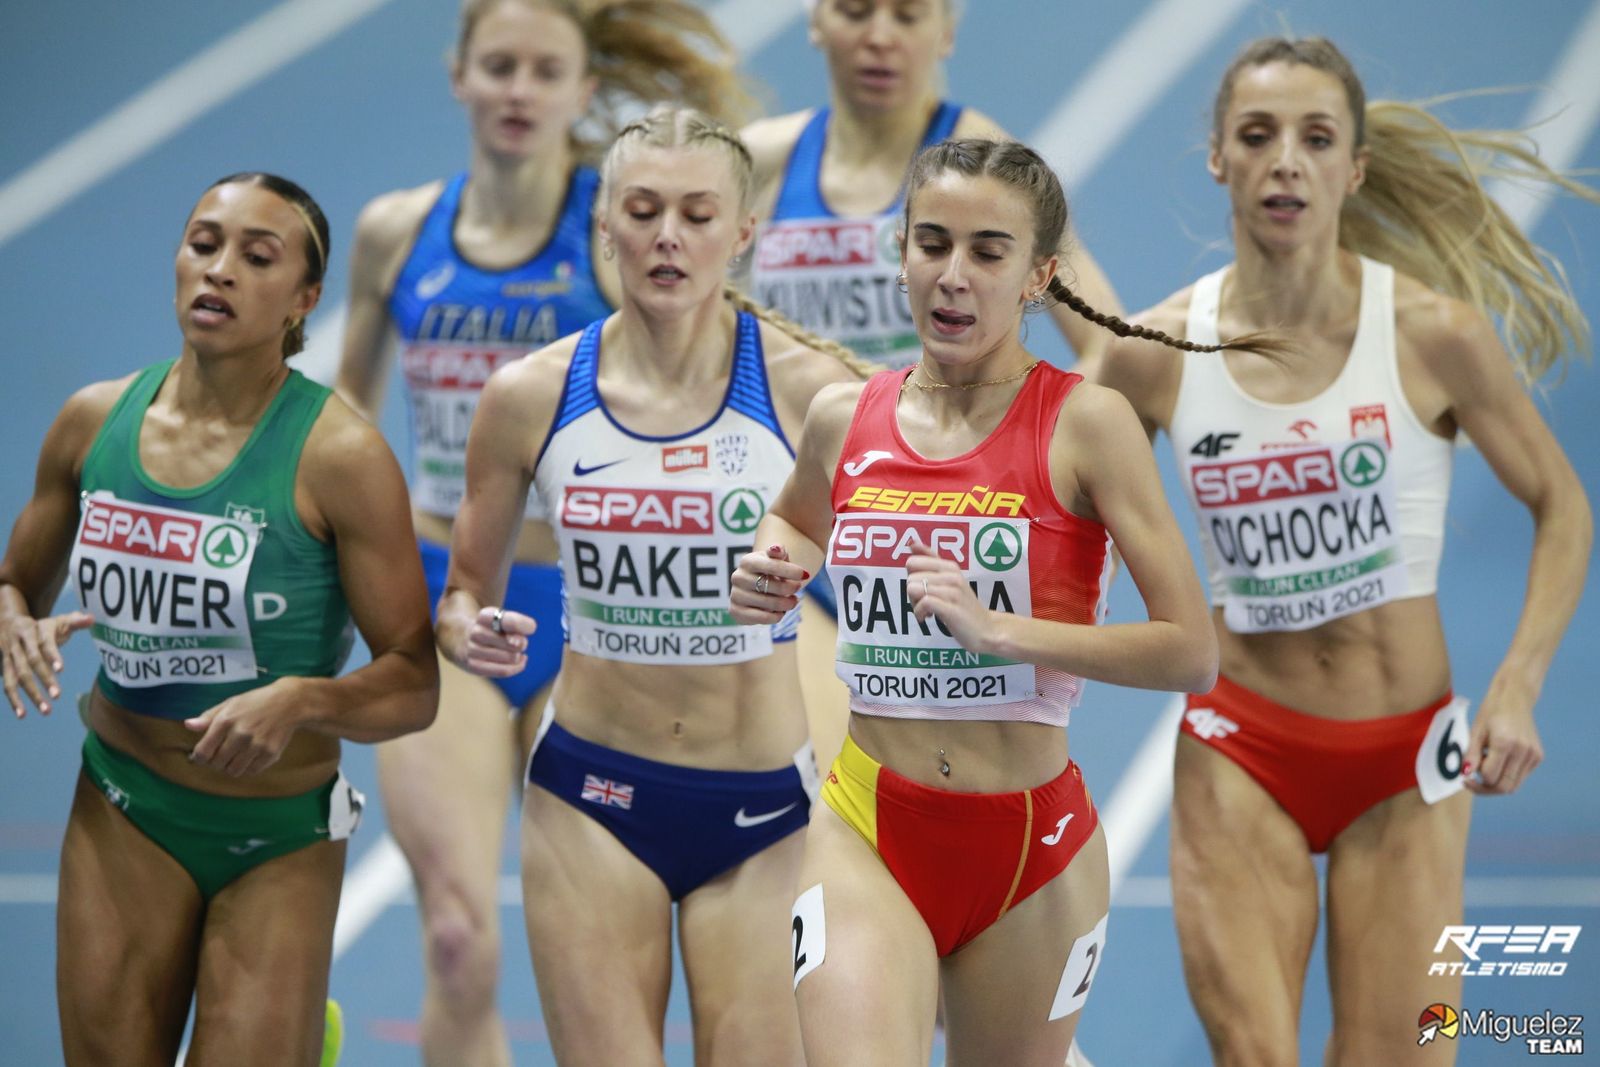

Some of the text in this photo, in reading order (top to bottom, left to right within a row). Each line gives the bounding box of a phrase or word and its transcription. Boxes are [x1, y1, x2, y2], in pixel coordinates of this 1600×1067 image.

[760, 226, 871, 266] SPAR
[418, 303, 558, 342] ITALIA
[1190, 432, 1241, 459] 4F
[1194, 456, 1334, 504] SPAR
[563, 491, 711, 530] SPAR
[847, 485, 1026, 516] ESPAÑA
[83, 508, 197, 557] SPAR
[836, 525, 966, 563] SPAR
[1210, 493, 1392, 568] CICHOCKA
[78, 556, 236, 629] POWER
[1298, 564, 1360, 590] CLEAN
[1333, 579, 1385, 613] 2021
[612, 608, 654, 625] RUN
[657, 608, 723, 626] CLEAN
[137, 635, 199, 651] CLEAN
[593, 628, 746, 656] TORUŃ 2021
[874, 648, 912, 665] RUN
[916, 650, 980, 667] CLEAN
[168, 655, 226, 676] 2021
[854, 673, 1007, 700] TORUŃ 2021
[1186, 707, 1240, 740] 4F
[1436, 718, 1463, 781] 6
[791, 915, 807, 980] 2
[1071, 941, 1098, 999] 2
